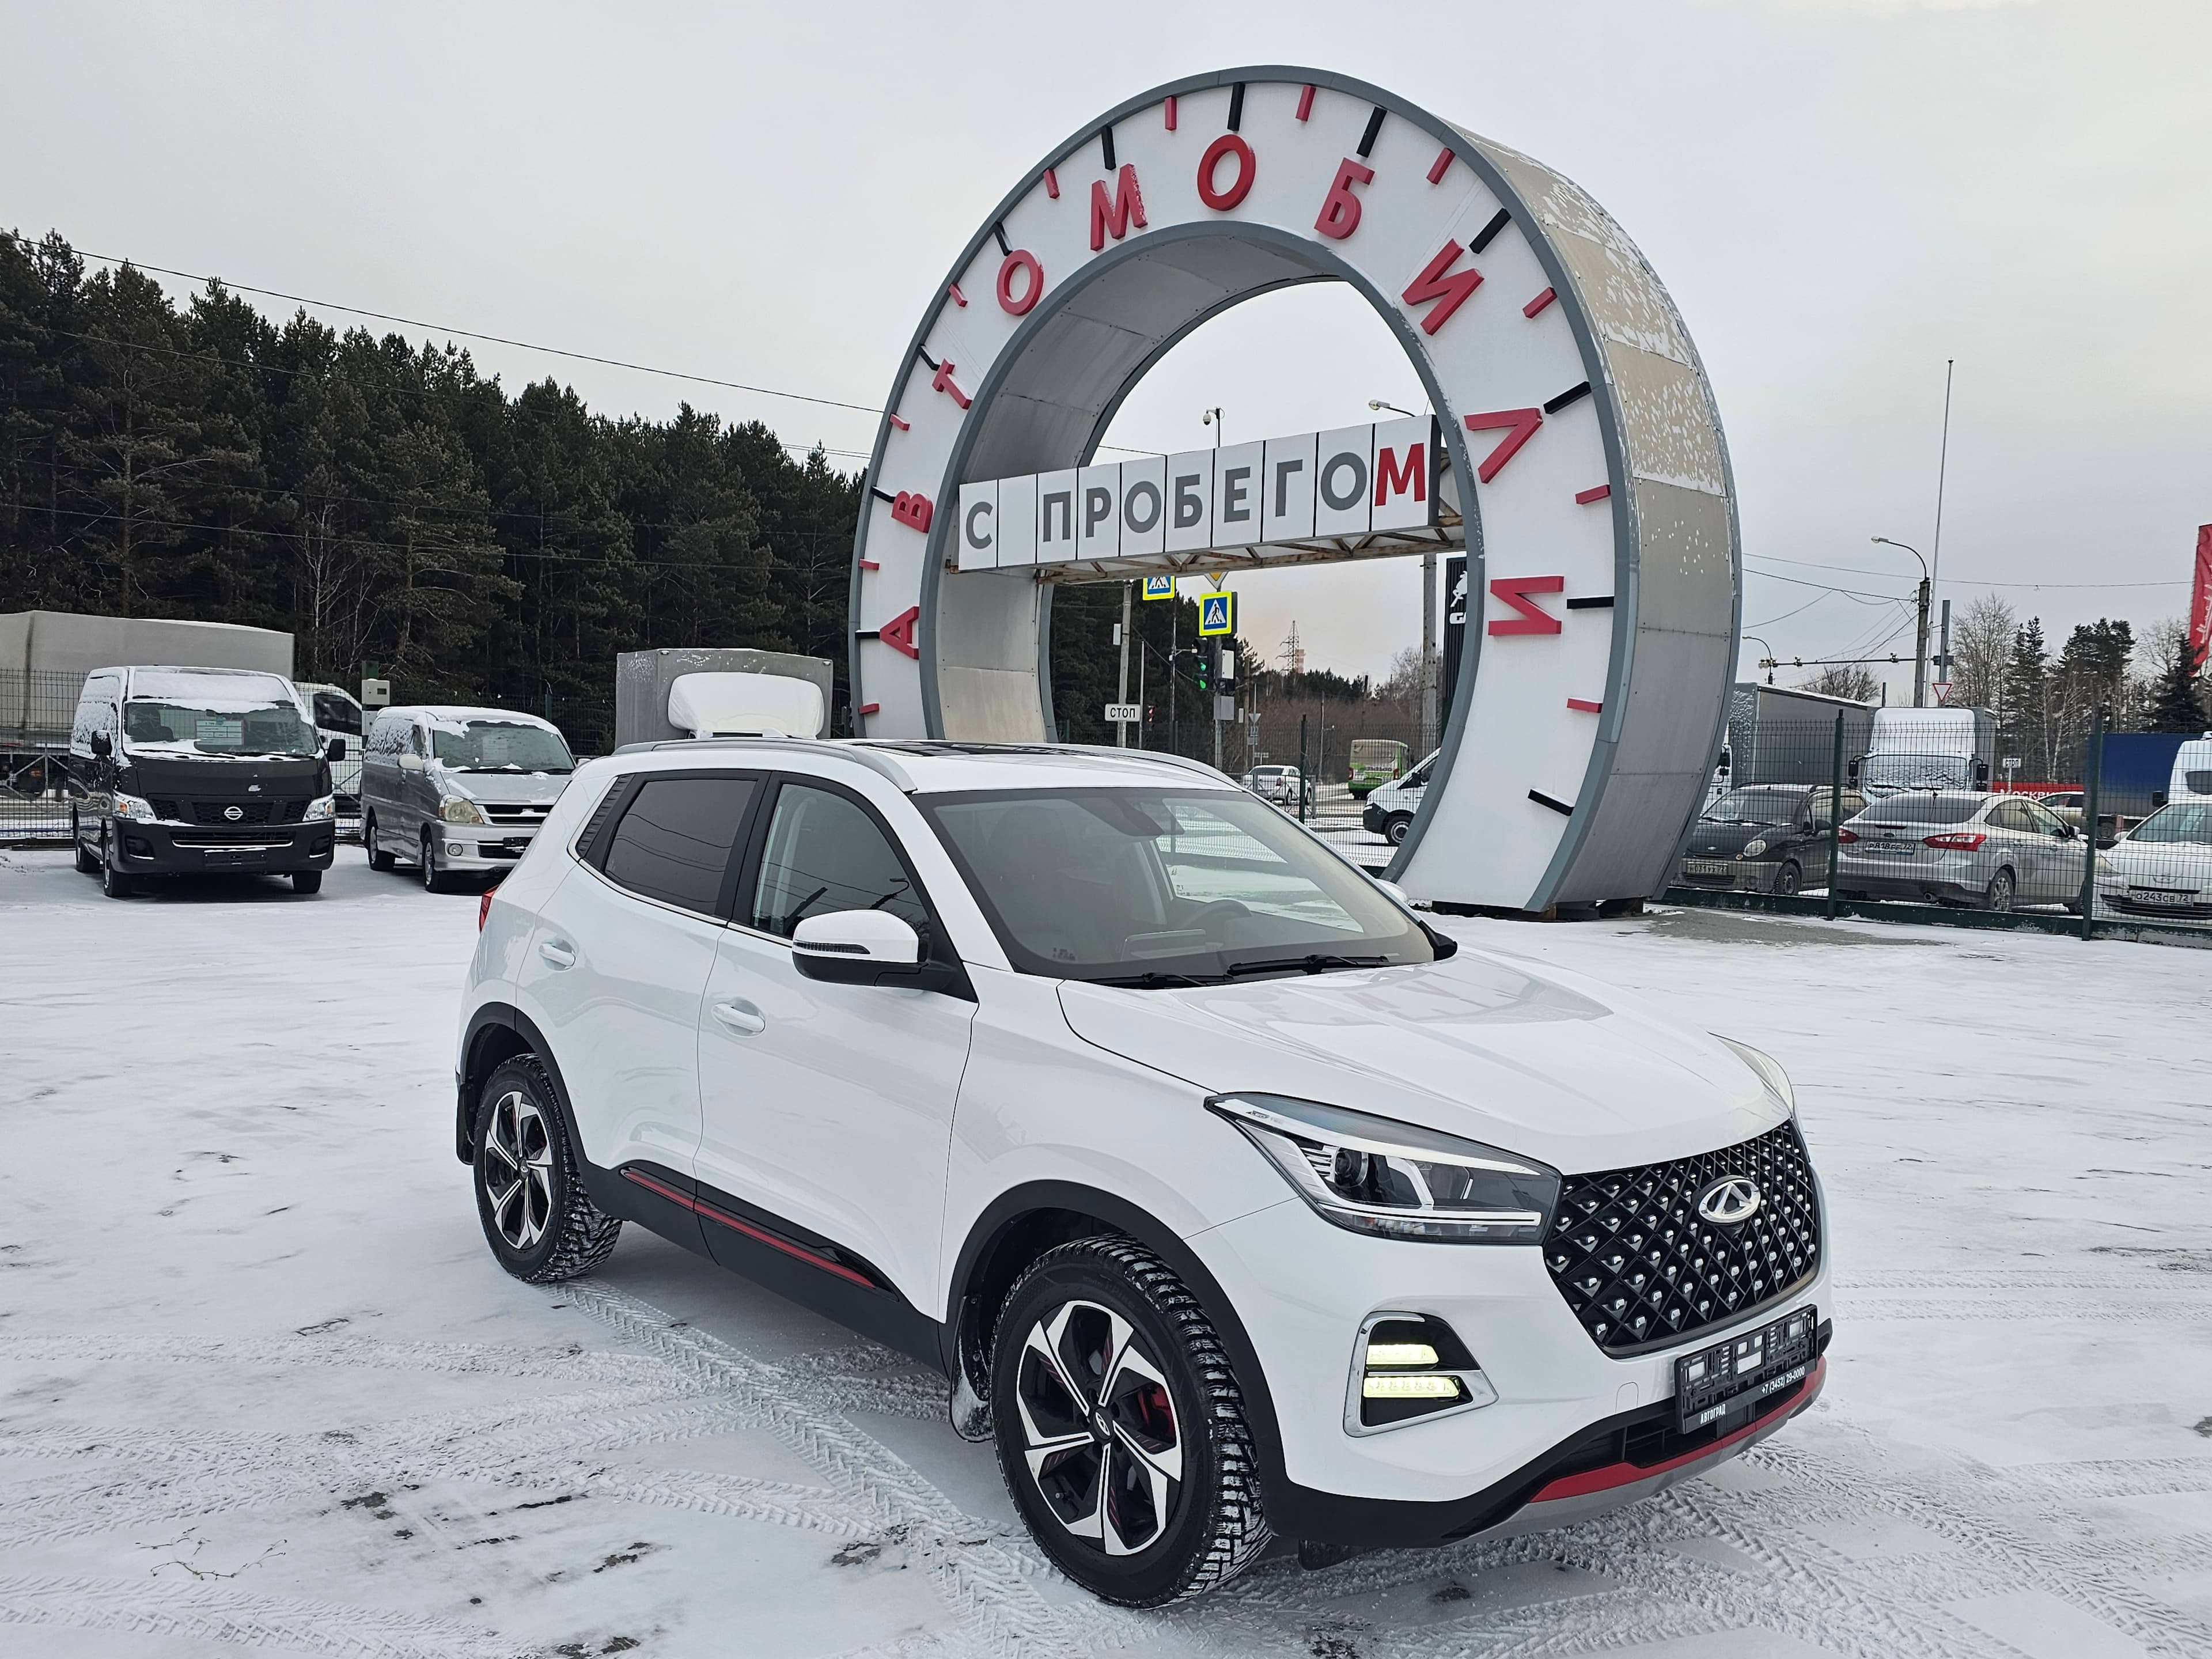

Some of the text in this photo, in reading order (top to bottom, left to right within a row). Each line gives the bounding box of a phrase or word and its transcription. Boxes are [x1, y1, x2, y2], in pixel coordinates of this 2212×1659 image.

[879, 134, 1564, 660] АВТОМОБИЛИ
[965, 442, 1427, 550] С ПРОБЕГОМ
[1110, 707, 1135, 718] СТОП
[2179, 893, 2189, 902] 72
[1769, 1376, 1786, 1393] (3452)
[1786, 1366, 1805, 1383] 29-0000
[1700, 1403, 1726, 1425] АВТОГРАД
